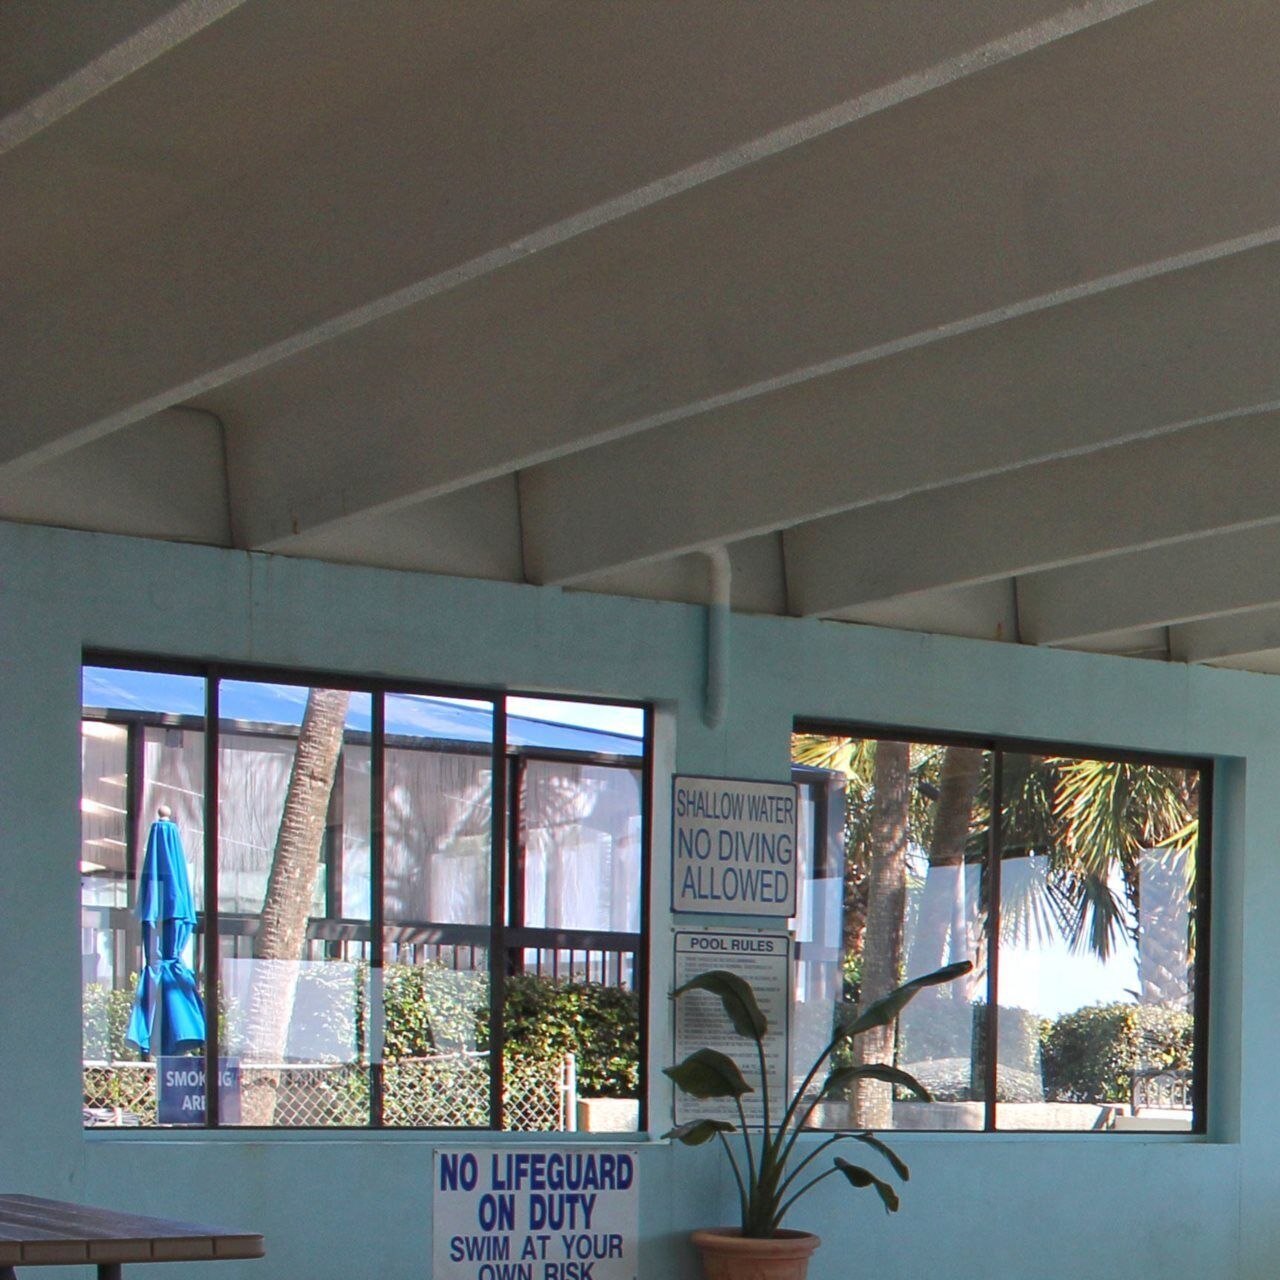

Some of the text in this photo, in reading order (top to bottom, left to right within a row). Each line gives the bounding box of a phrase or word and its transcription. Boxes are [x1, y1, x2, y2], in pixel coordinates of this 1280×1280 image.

[677, 788, 793, 824] SHALLOW WATER
[678, 828, 792, 865] NO DIVING
[681, 866, 788, 903] ALLOWED
[690, 938, 774, 953] POOL RULES
[166, 1070, 232, 1088] SMOKG
[440, 1153, 633, 1191] NO LIFEGUARD
[479, 1194, 597, 1231] ON DUTY
[450, 1234, 623, 1262] SWIM AT YOUR
